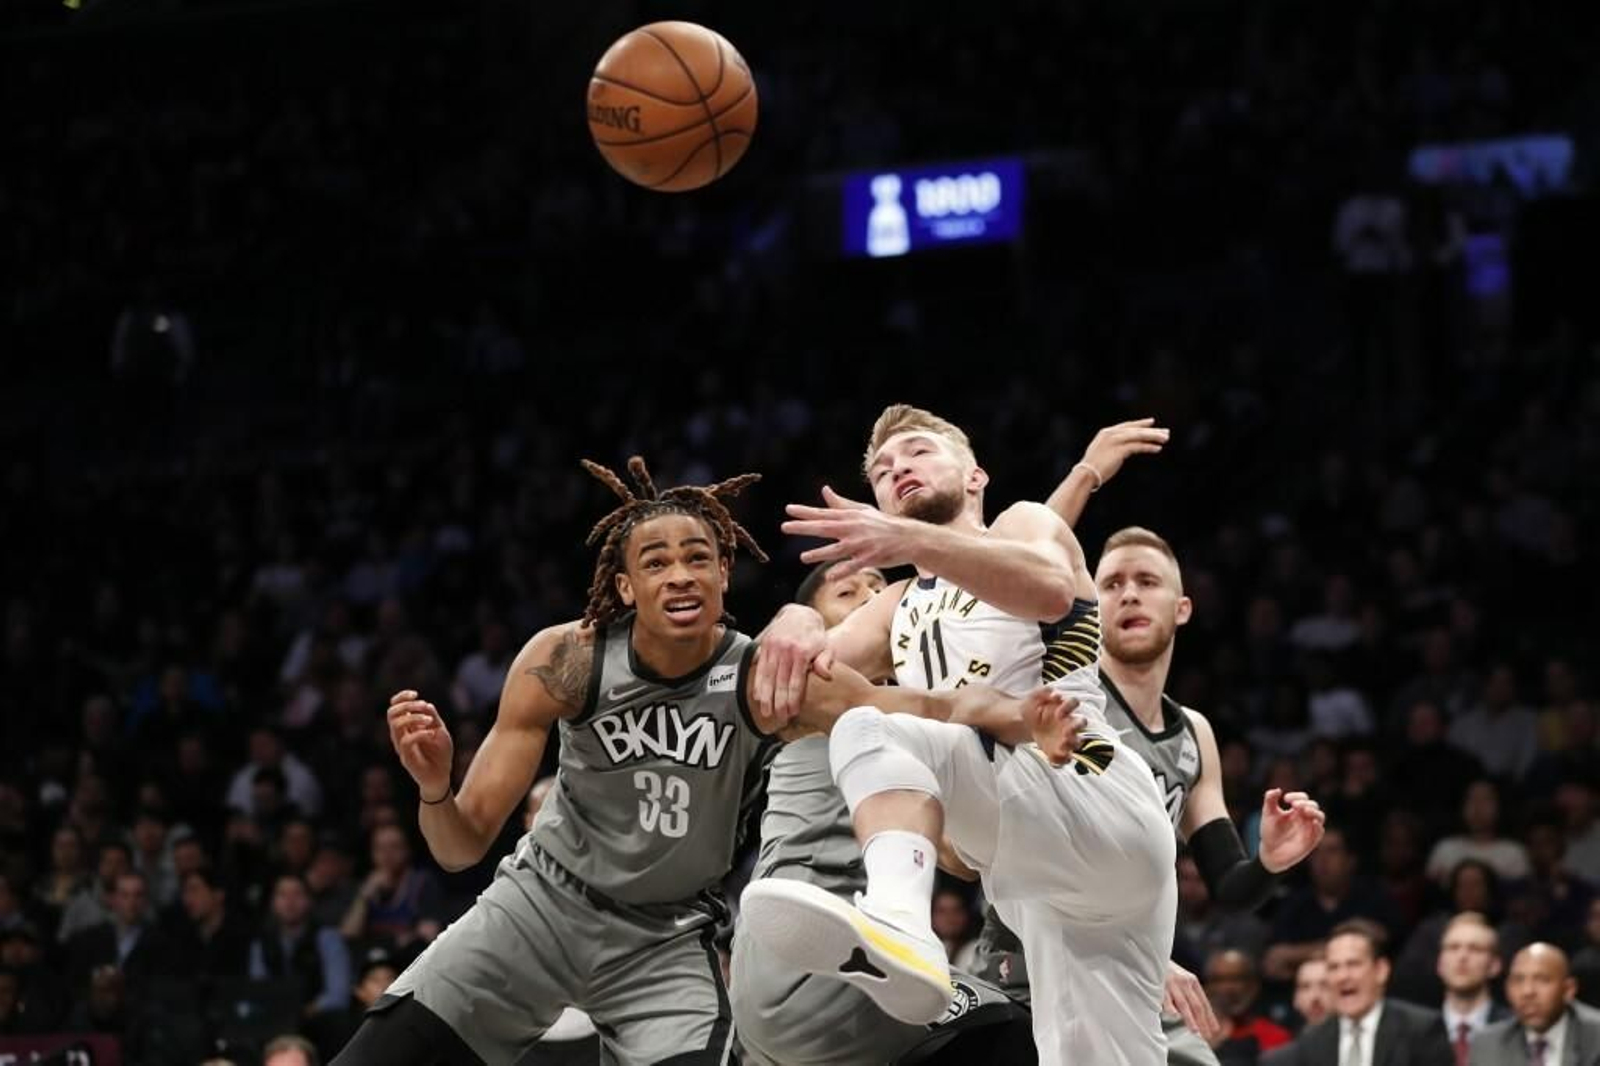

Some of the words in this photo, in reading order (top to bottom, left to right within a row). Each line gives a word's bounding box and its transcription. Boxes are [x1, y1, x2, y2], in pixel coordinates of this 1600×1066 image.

[920, 617, 948, 690] 11
[591, 704, 736, 769] BKLYN
[633, 770, 690, 838] 33
